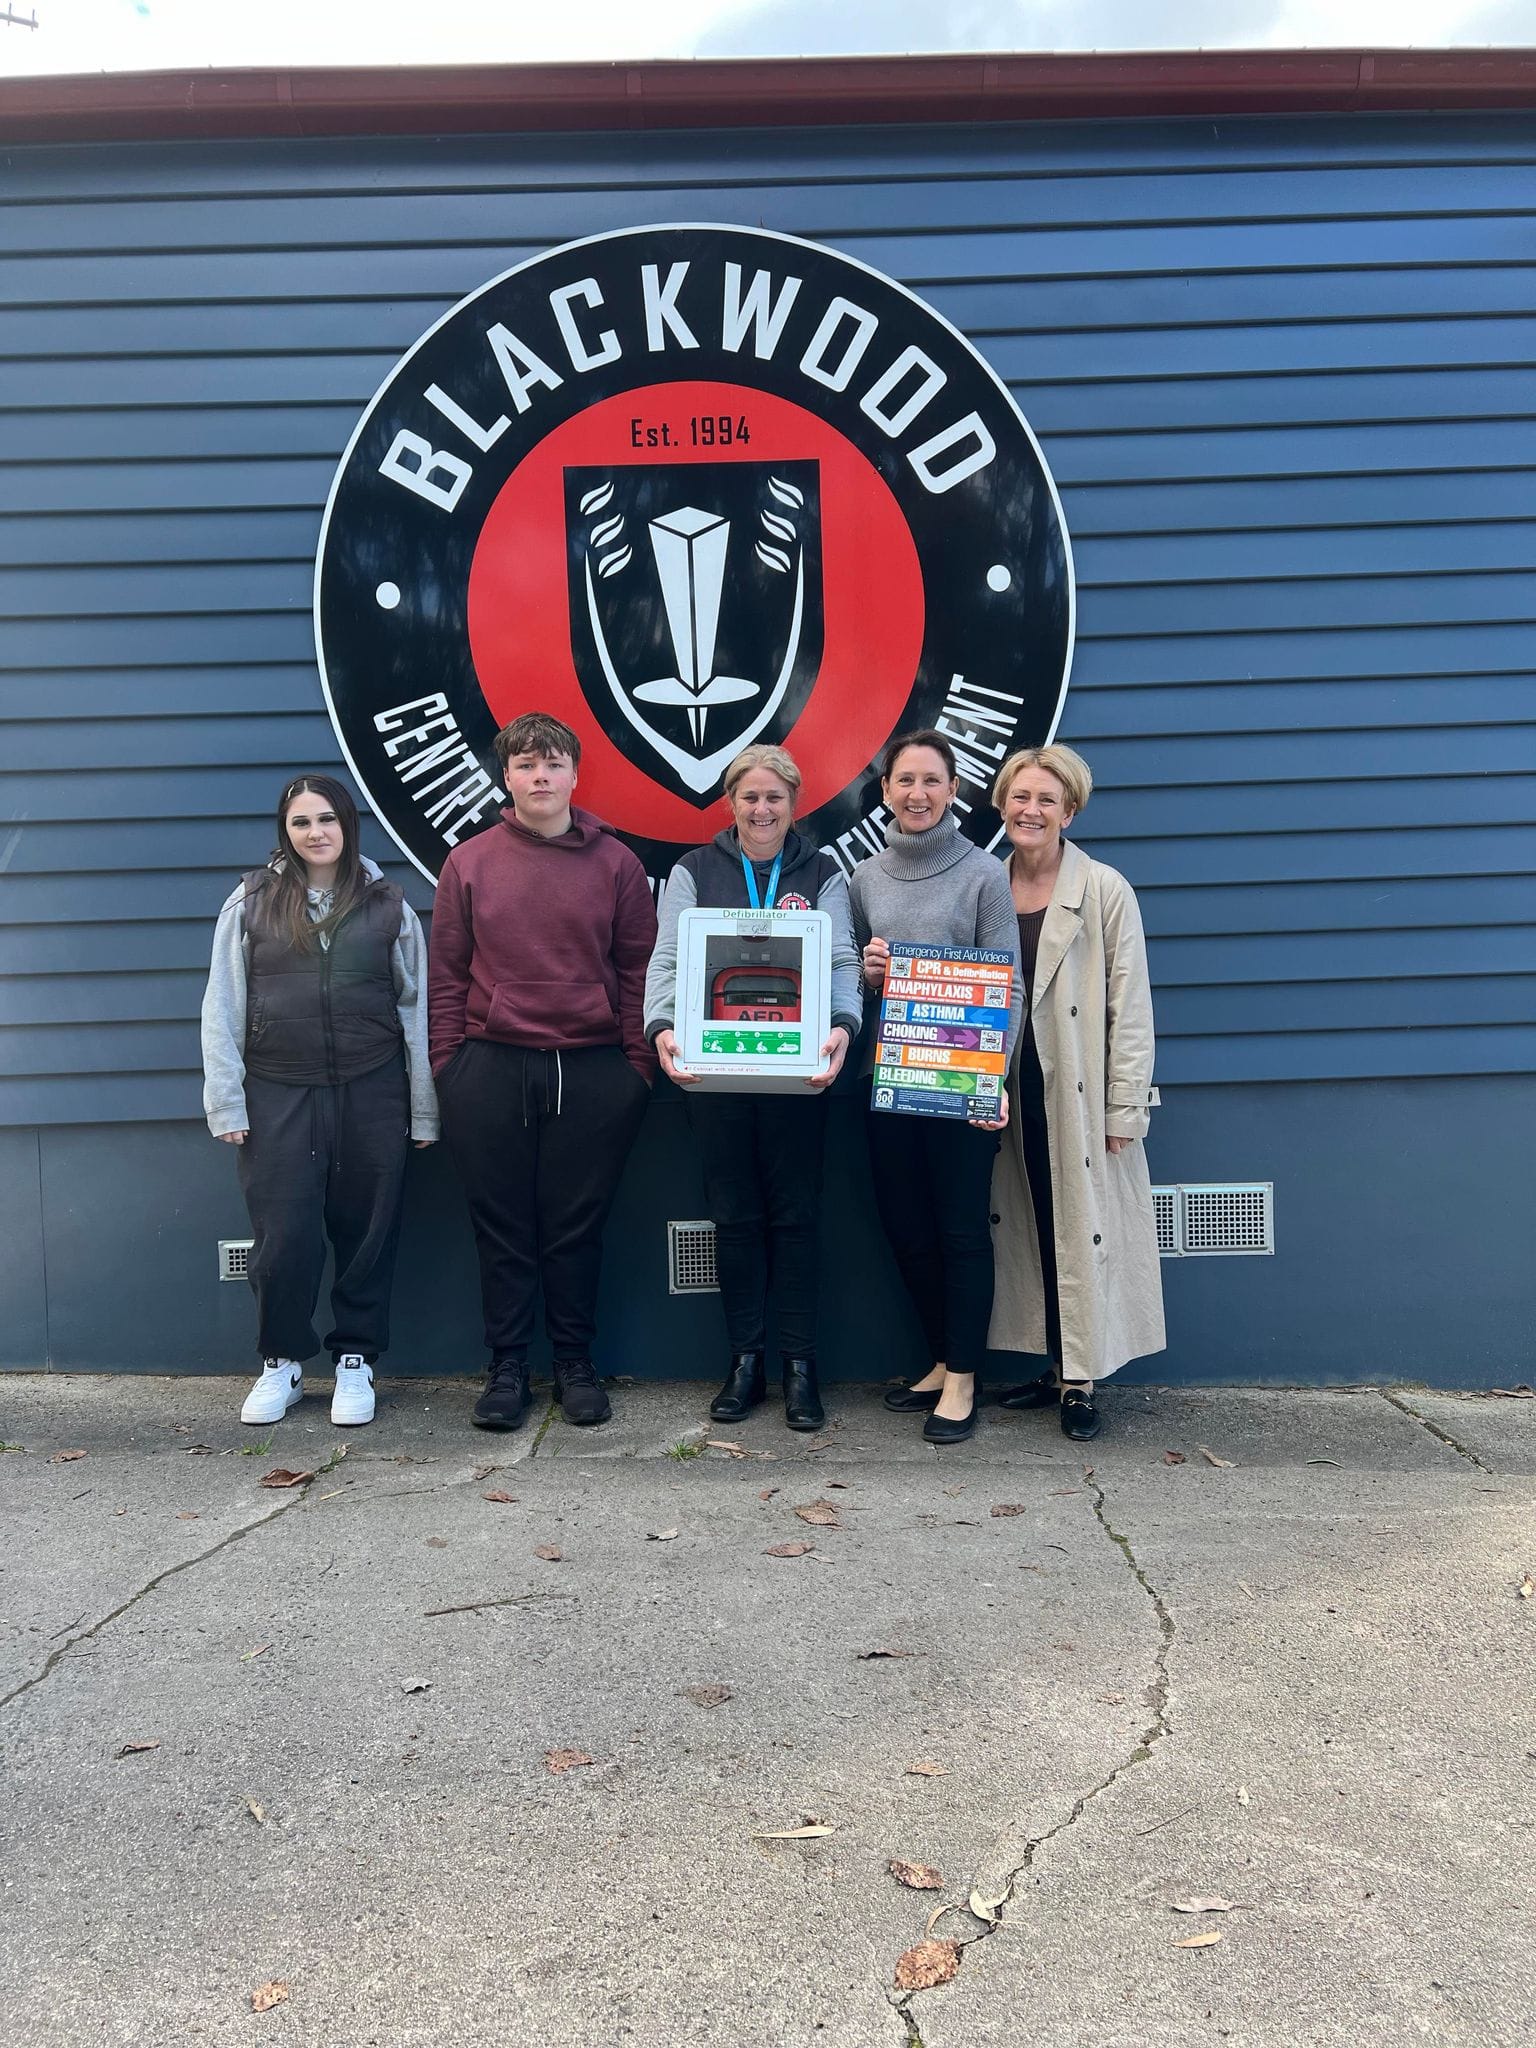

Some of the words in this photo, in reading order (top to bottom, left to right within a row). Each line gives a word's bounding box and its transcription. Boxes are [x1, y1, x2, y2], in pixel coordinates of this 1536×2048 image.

[378, 261, 998, 513] BLACKWOOD
[631, 418, 679, 448] Est.
[690, 415, 752, 447] 1994
[373, 692, 506, 848] CENTRE
[722, 909, 788, 919] Defibrillator
[893, 943, 942, 960] Emergency
[943, 948, 962, 960] First
[963, 950, 978, 962] Aid
[979, 951, 1009, 964] Videos
[916, 960, 942, 975] CPR
[943, 966, 952, 976] &
[952, 966, 1009, 980] Defibrillation
[888, 979, 974, 1000] ANAPHYLAXIS
[738, 1010, 784, 1022] AED
[912, 1003, 966, 1021] ASTHMA
[883, 1022, 938, 1041] CHOKING
[907, 1047, 951, 1064] BURNS
[878, 1066, 937, 1085] BLEEDING
[876, 1093, 894, 1103] 000
